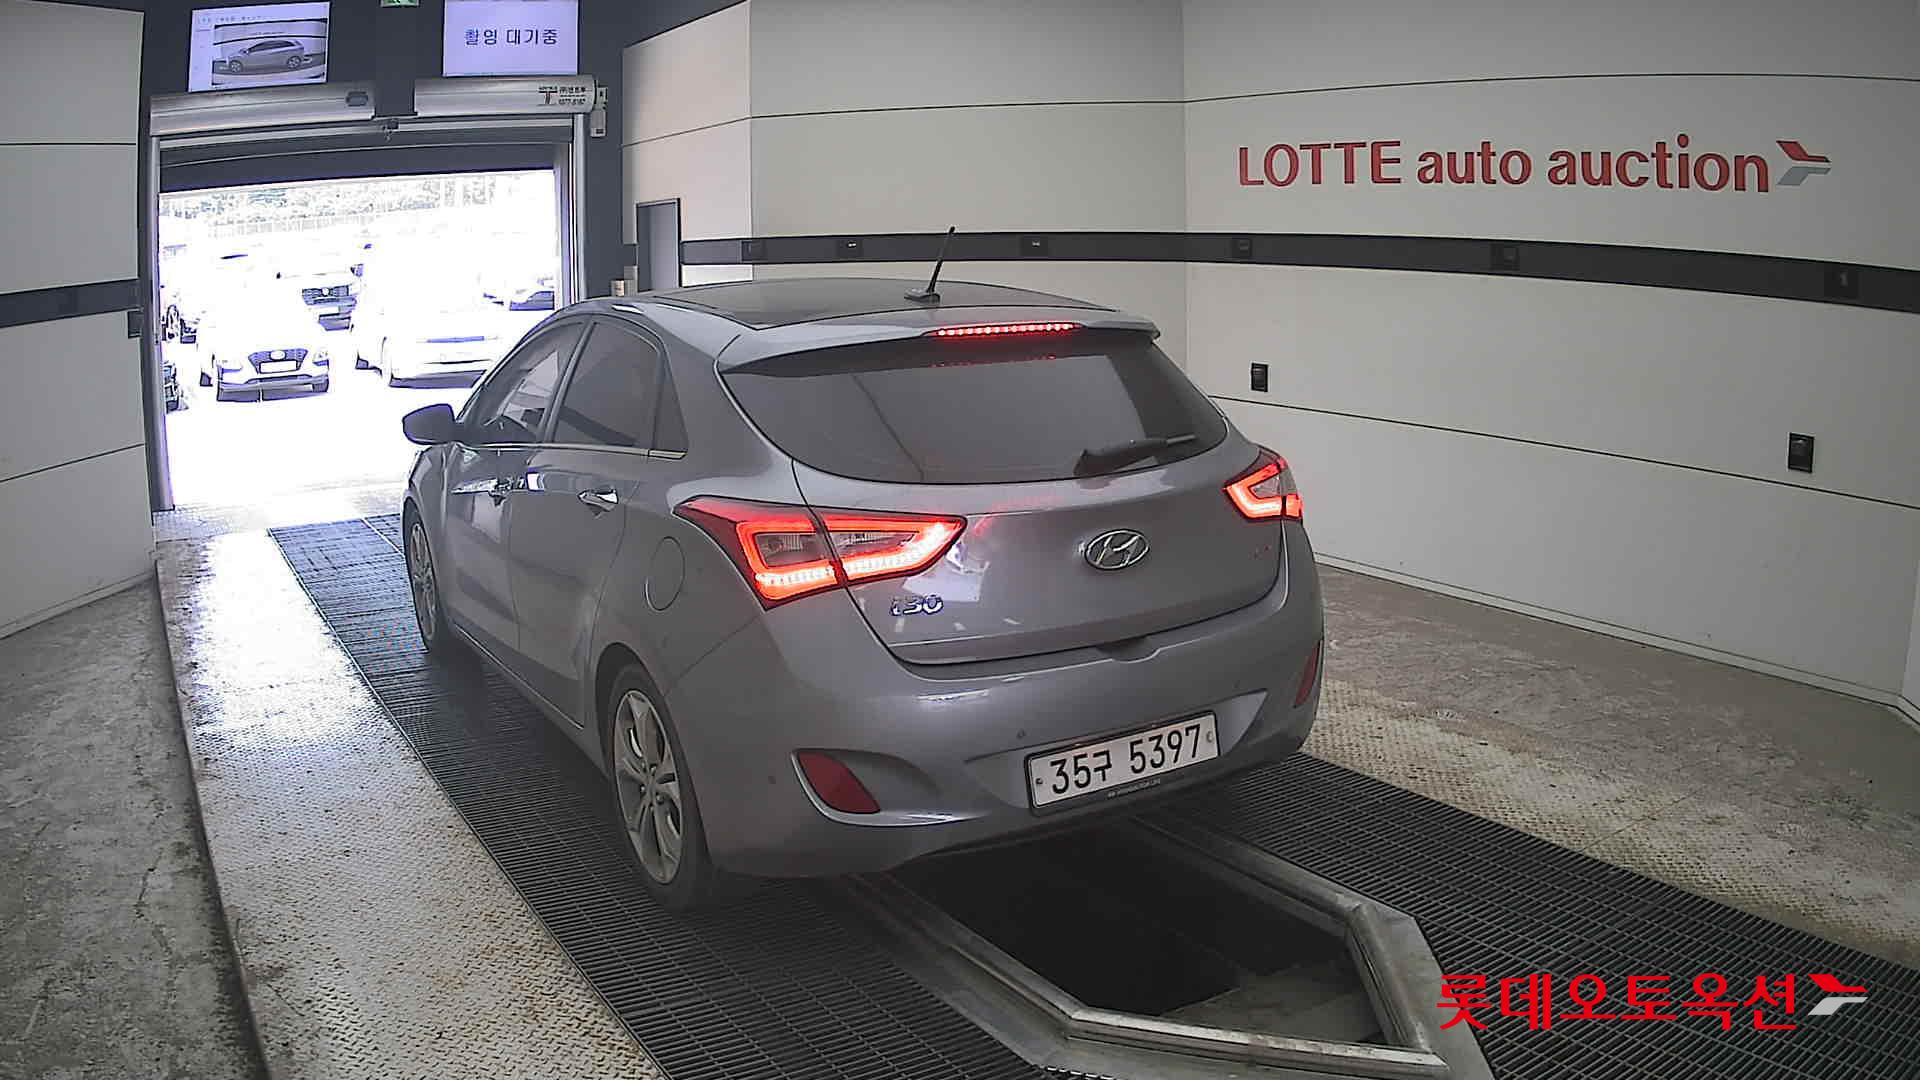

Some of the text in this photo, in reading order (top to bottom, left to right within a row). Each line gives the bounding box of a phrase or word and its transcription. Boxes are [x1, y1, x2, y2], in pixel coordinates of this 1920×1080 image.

[506, 29, 558, 45] 대기중
[1239, 133, 1769, 193] LOTTE auto auction
[889, 595, 944, 616] i30
[1050, 749, 1113, 795] 35구
[1129, 723, 1201, 775] 5397
